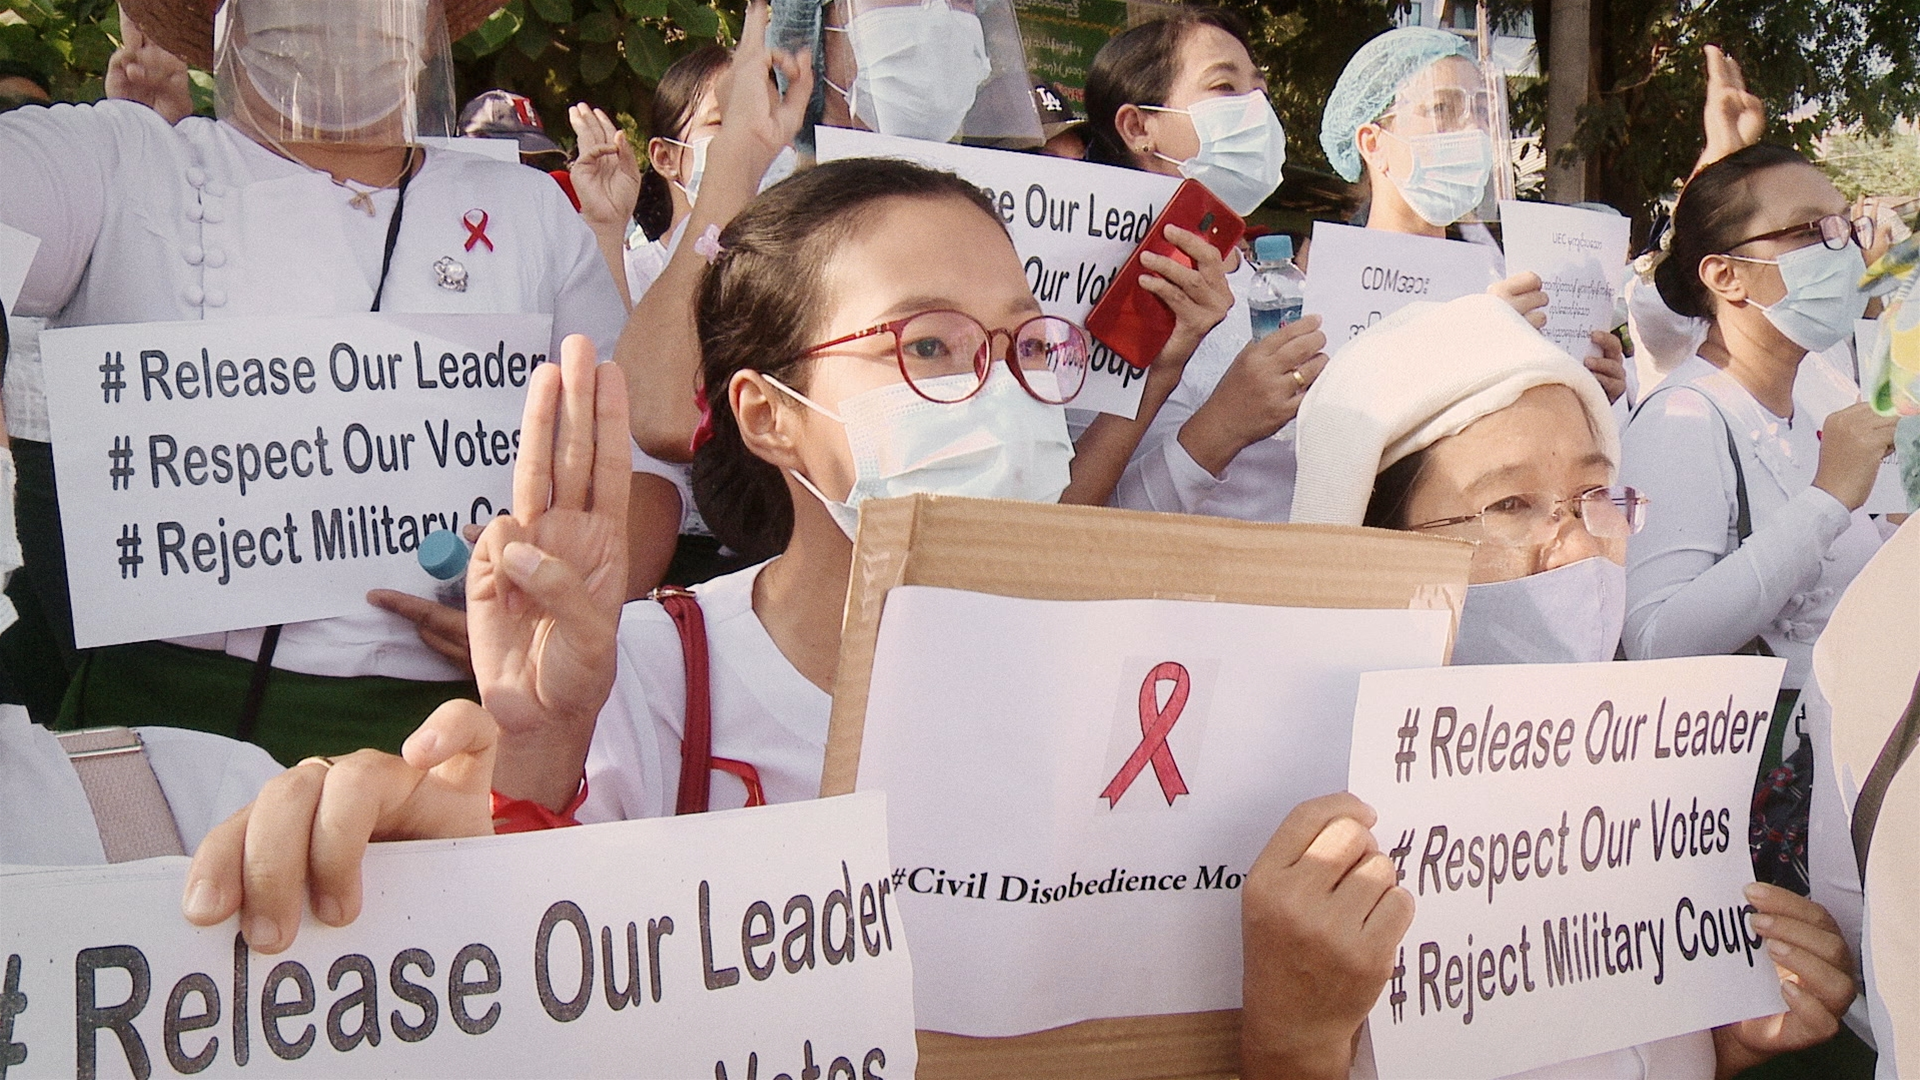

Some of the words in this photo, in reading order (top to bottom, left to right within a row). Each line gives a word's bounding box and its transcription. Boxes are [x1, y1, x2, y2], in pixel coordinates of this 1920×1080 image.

[1025, 183, 1080, 233] Our
[1087, 193, 1153, 244] Lead
[1024, 256, 1070, 303] Our
[99, 352, 126, 403] #
[140, 347, 316, 401] Release
[329, 342, 403, 393] Our
[1086, 340, 1146, 389] oup
[108, 435, 135, 490] #
[148, 426, 334, 497] Respect
[342, 422, 415, 474] Our
[116, 523, 144, 579] #
[156, 512, 302, 586] Reject
[1394, 707, 1421, 783] #
[1430, 704, 1575, 779] Release
[1585, 700, 1648, 765] Our
[1654, 694, 1768, 757] Leader
[891, 867, 988, 900] #Civil
[998, 868, 1187, 904] Disobedience
[1389, 828, 1415, 887] #
[1419, 810, 1570, 904] Respect
[1580, 805, 1641, 872] Our
[1651, 796, 1730, 862] Votes
[75, 930, 502, 1080] Release
[534, 899, 675, 1023] Our
[698, 860, 894, 991] Leader
[1389, 946, 1408, 1025] #
[1419, 925, 1536, 1025] Reject
[1543, 912, 1665, 985] Military
[1675, 896, 1764, 967] Coup
